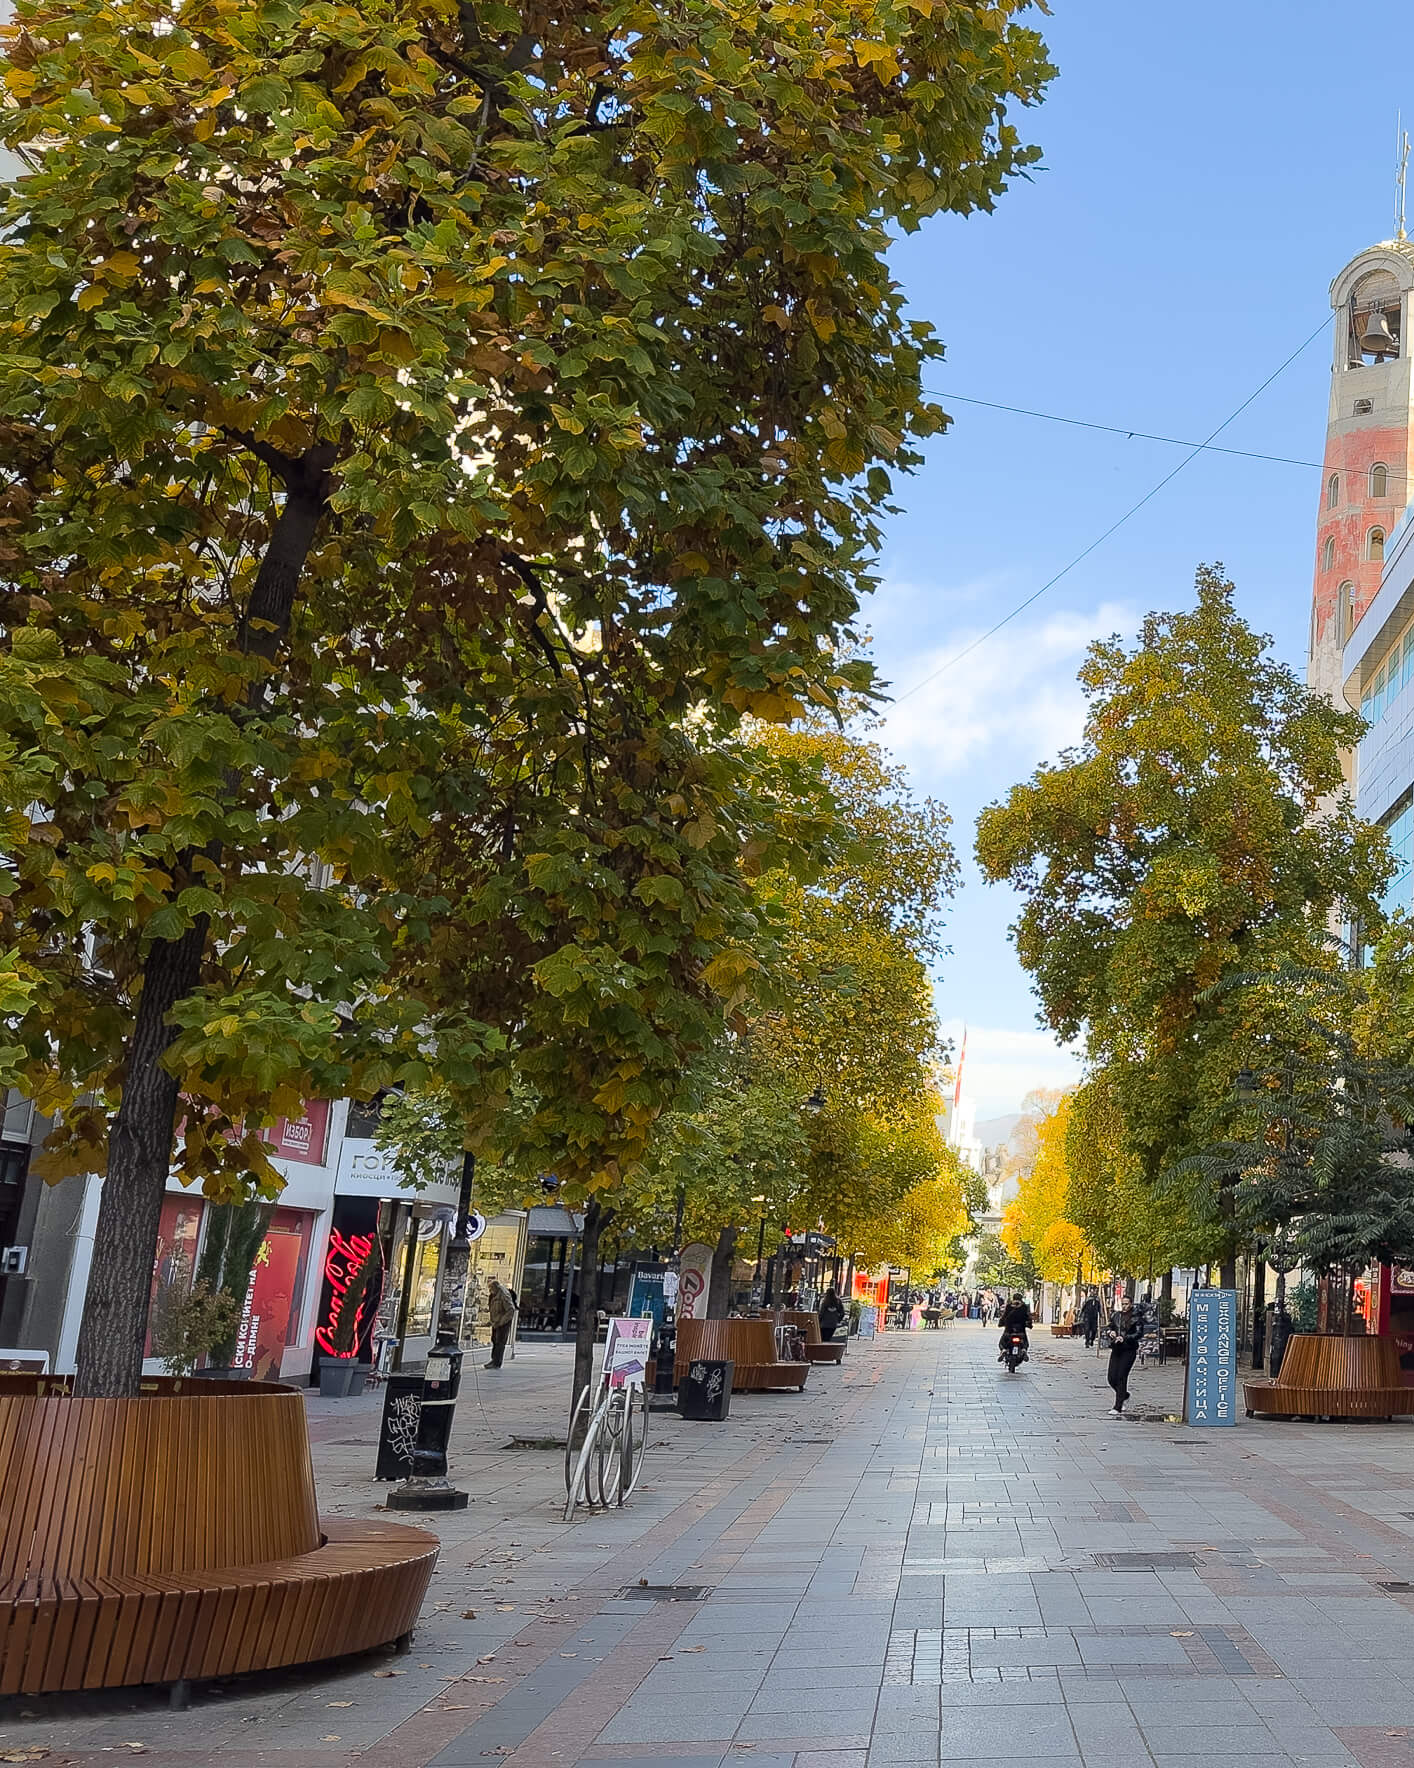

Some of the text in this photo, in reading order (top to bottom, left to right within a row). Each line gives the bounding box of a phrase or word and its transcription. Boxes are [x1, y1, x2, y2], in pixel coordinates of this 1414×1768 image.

[1195, 1303, 1209, 1419] МЕНУВАЧНИЦА
[1216, 1301, 1230, 1418] EXCHANGE OFFICE
